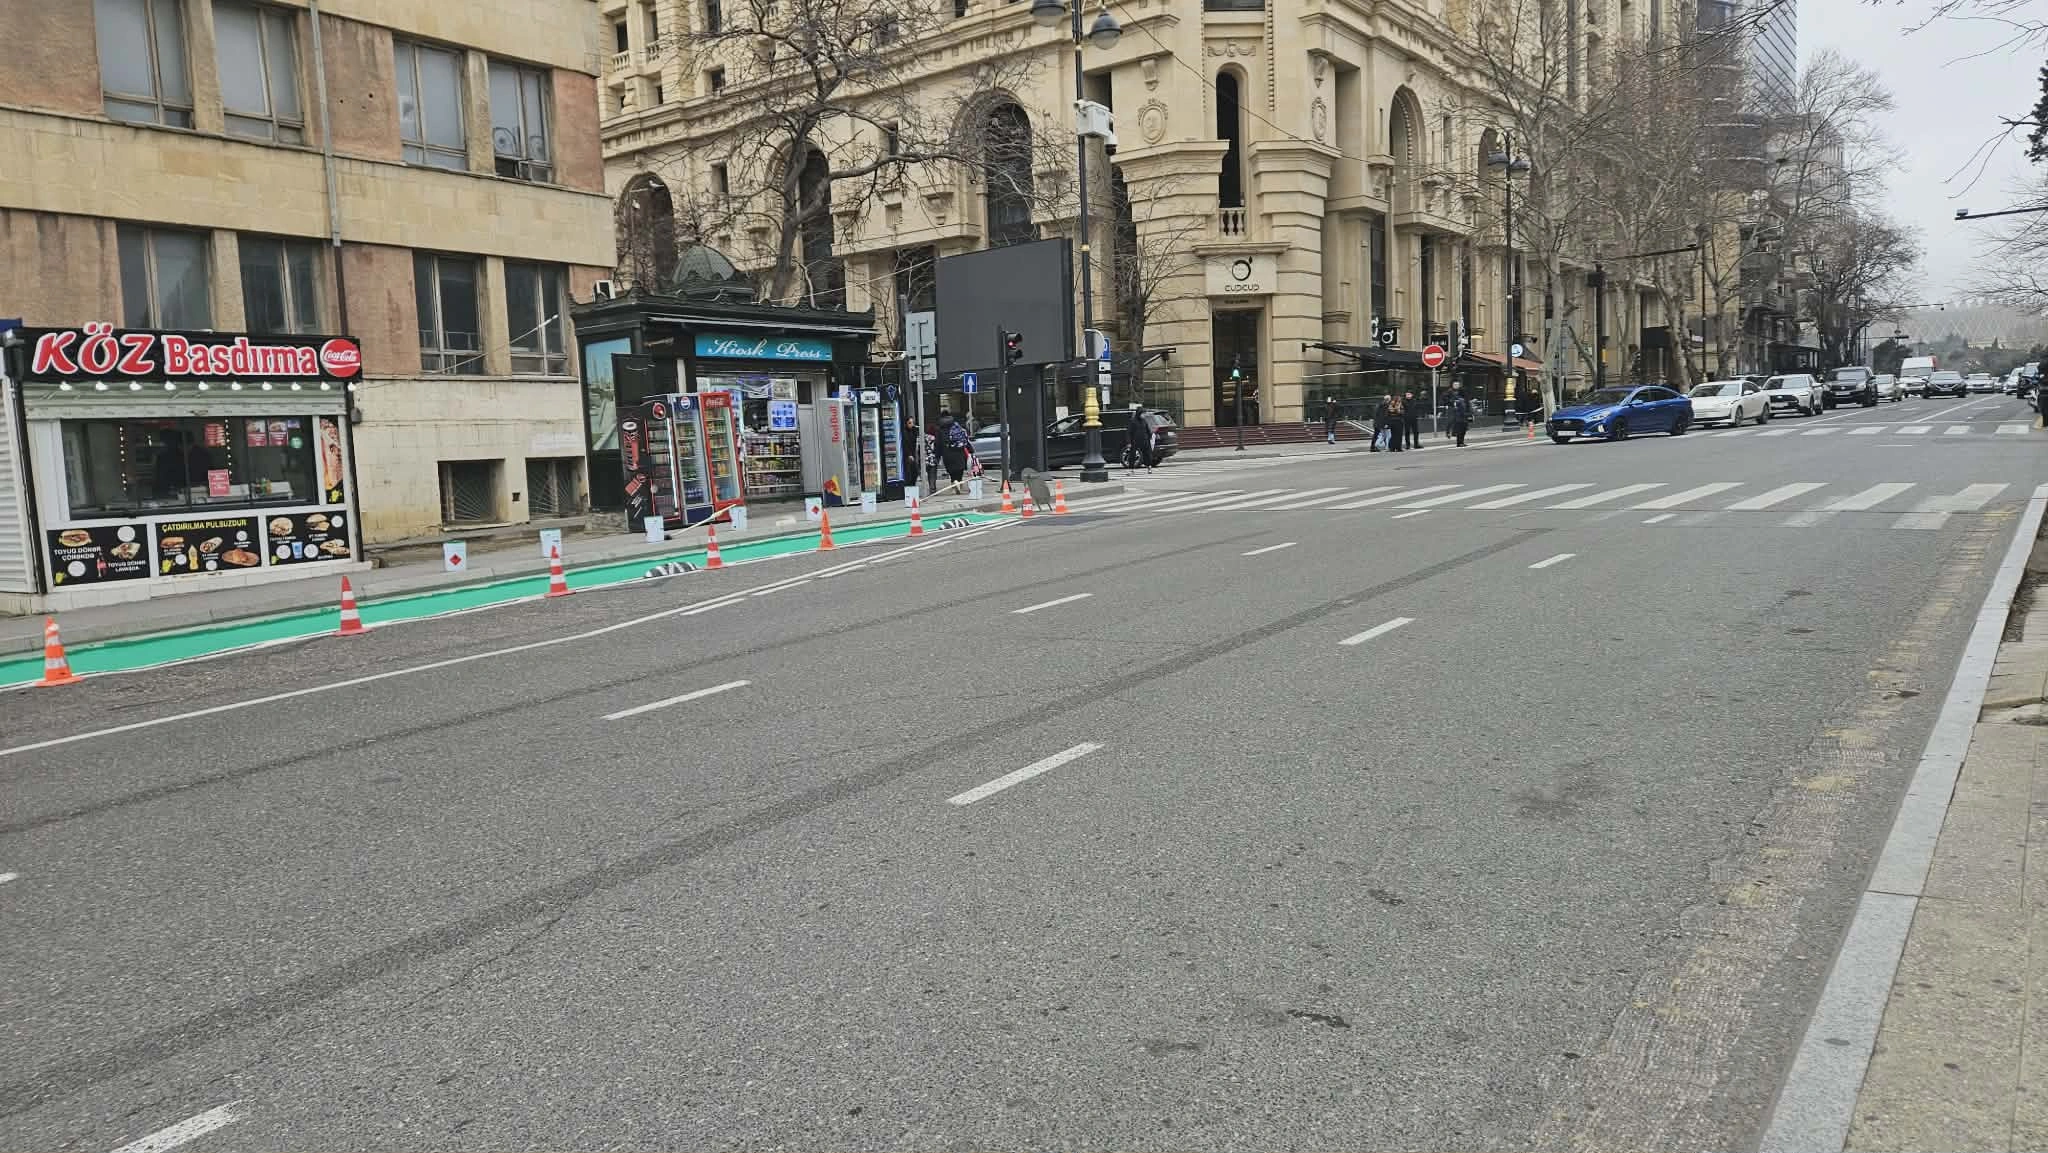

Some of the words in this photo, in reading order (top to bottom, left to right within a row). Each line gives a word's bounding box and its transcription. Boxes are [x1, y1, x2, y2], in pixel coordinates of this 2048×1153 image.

[32, 322, 155, 375] KÖZ
[161, 335, 320, 376] Basdırma
[707, 338, 768, 356] Kiosk
[776, 342, 821, 359] Press
[162, 521, 205, 533] ÇATDIRILMA
[205, 519, 247, 530] PULSUZDUR
